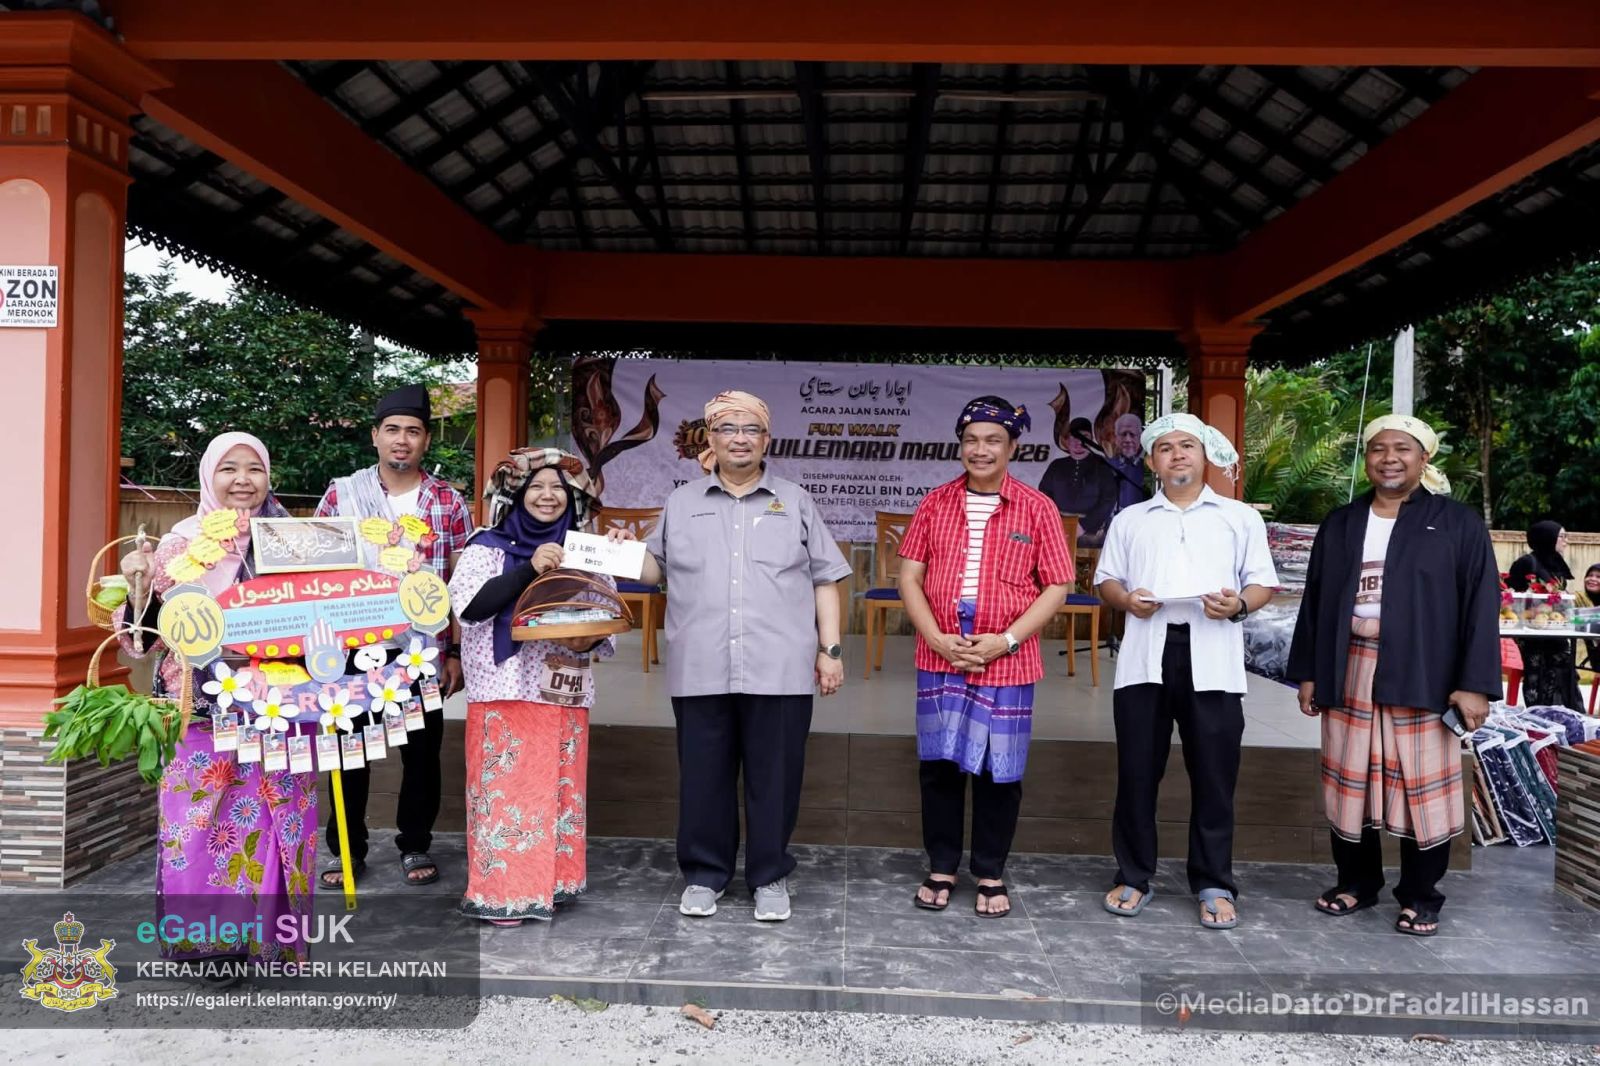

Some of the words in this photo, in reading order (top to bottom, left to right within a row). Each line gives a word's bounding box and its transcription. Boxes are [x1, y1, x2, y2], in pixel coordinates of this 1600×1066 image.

[17, 269, 47, 277] BERADA
[50, 269, 56, 277] DI
[6, 280, 56, 299] ZON
[6, 300, 56, 308] LARANGAN
[8, 309, 53, 317] MEROKOK
[801, 406, 836, 415] ACARA
[839, 407, 871, 416] JALAN
[874, 407, 911, 416] SANTAI
[808, 423, 844, 437] FUN
[848, 423, 901, 437] WALK
[766, 438, 897, 460] UILLEMARD
[900, 442, 961, 461] MAUL
[803, 473, 876, 481] DISEMPURNAKAN
[831, 485, 876, 495] FADZLI
[880, 486, 902, 496] BIN
[906, 487, 936, 496] DAT
[813, 498, 856, 507] MENTERI
[859, 498, 890, 507] BESAR
[894, 499, 920, 507] KELA
[301, 578, 344, 597] مولد
[229, 581, 295, 608] الرسول
